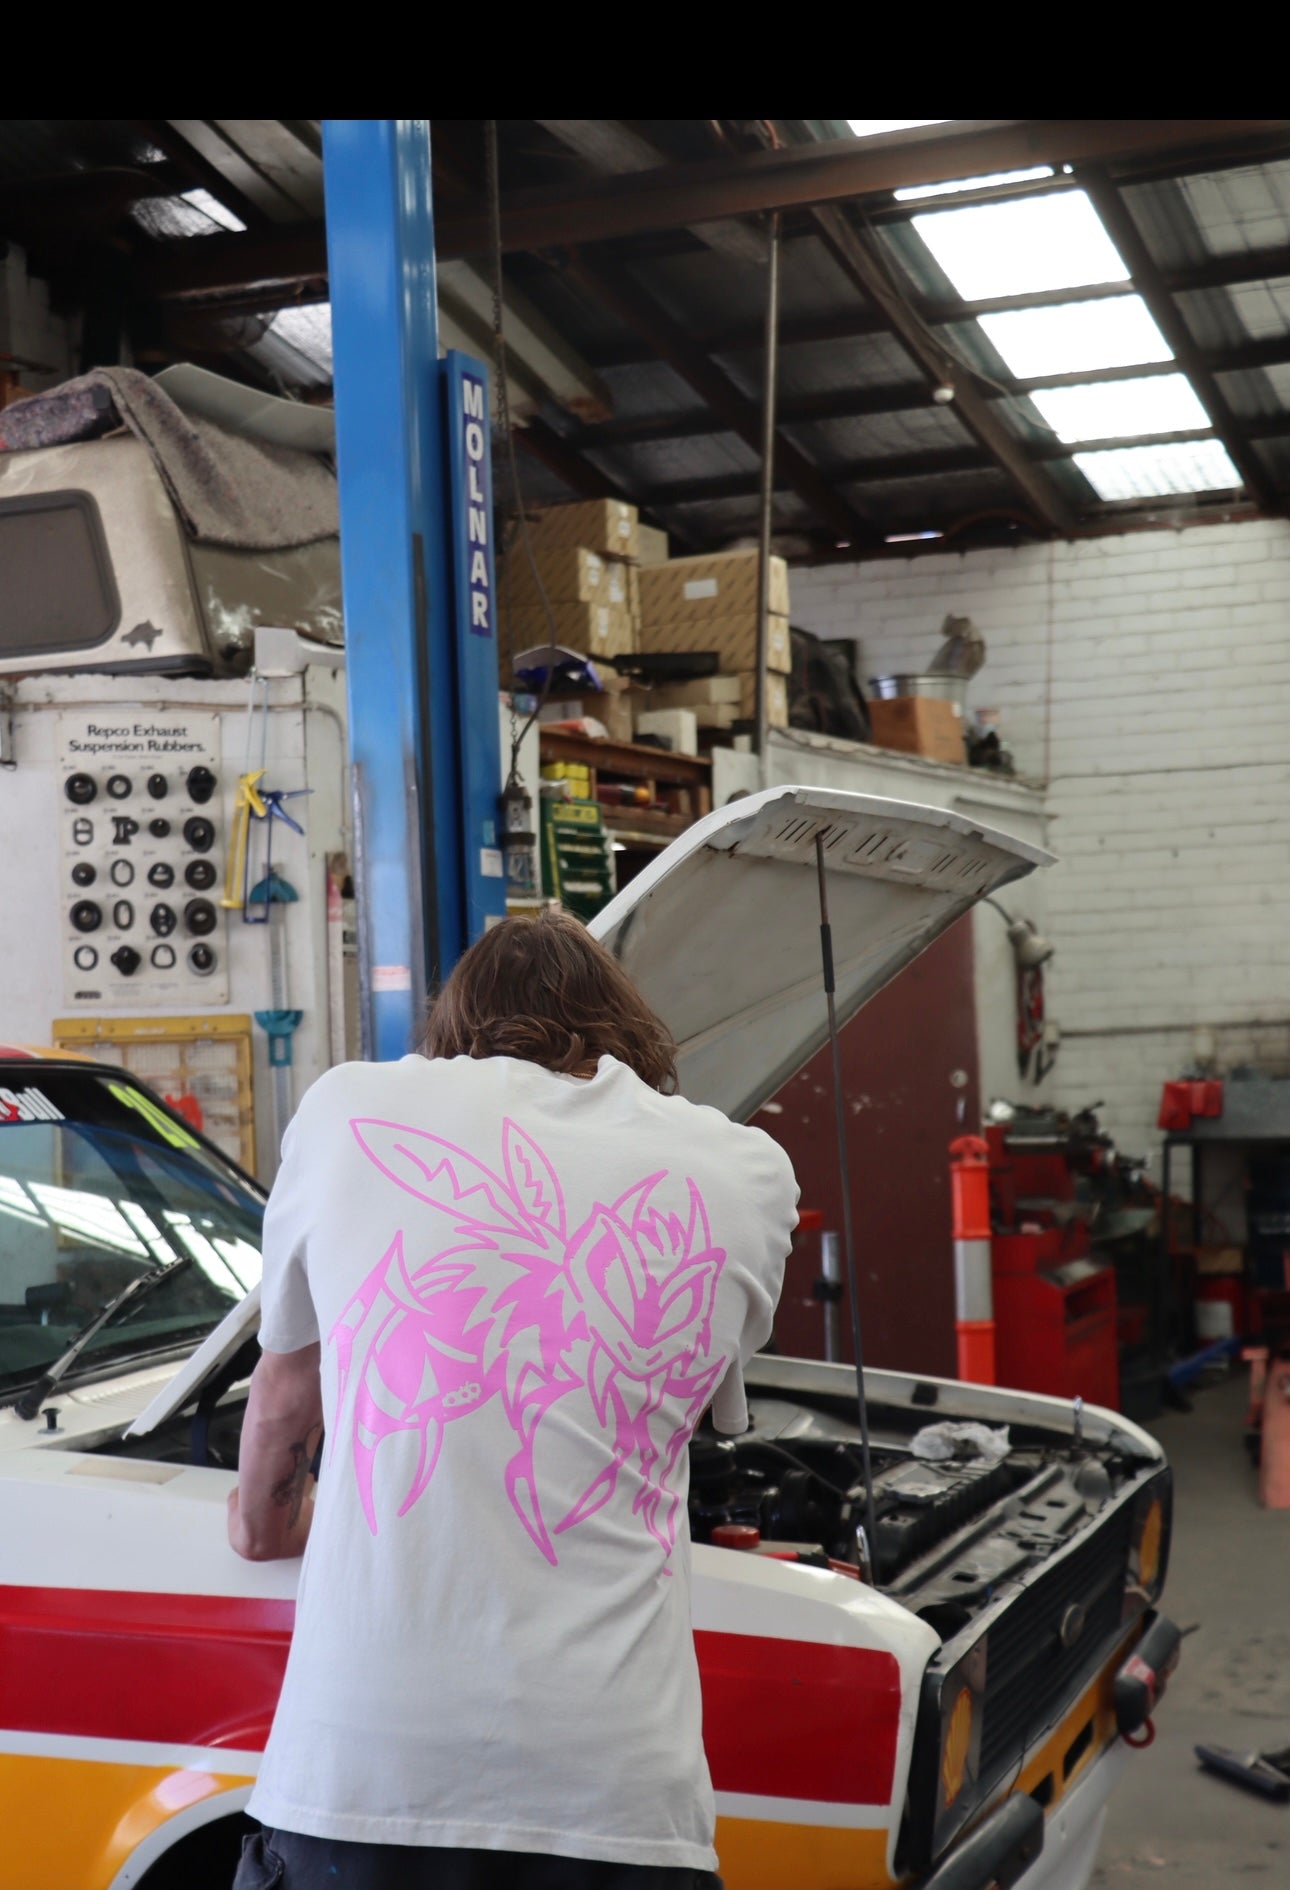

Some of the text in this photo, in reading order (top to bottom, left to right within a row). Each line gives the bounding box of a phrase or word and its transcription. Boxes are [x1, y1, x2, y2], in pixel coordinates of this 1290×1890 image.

[462, 379, 489, 628] MOLNAR
[87, 725, 187, 739] Repco Exhaust
[69, 740, 144, 754] Suspension
